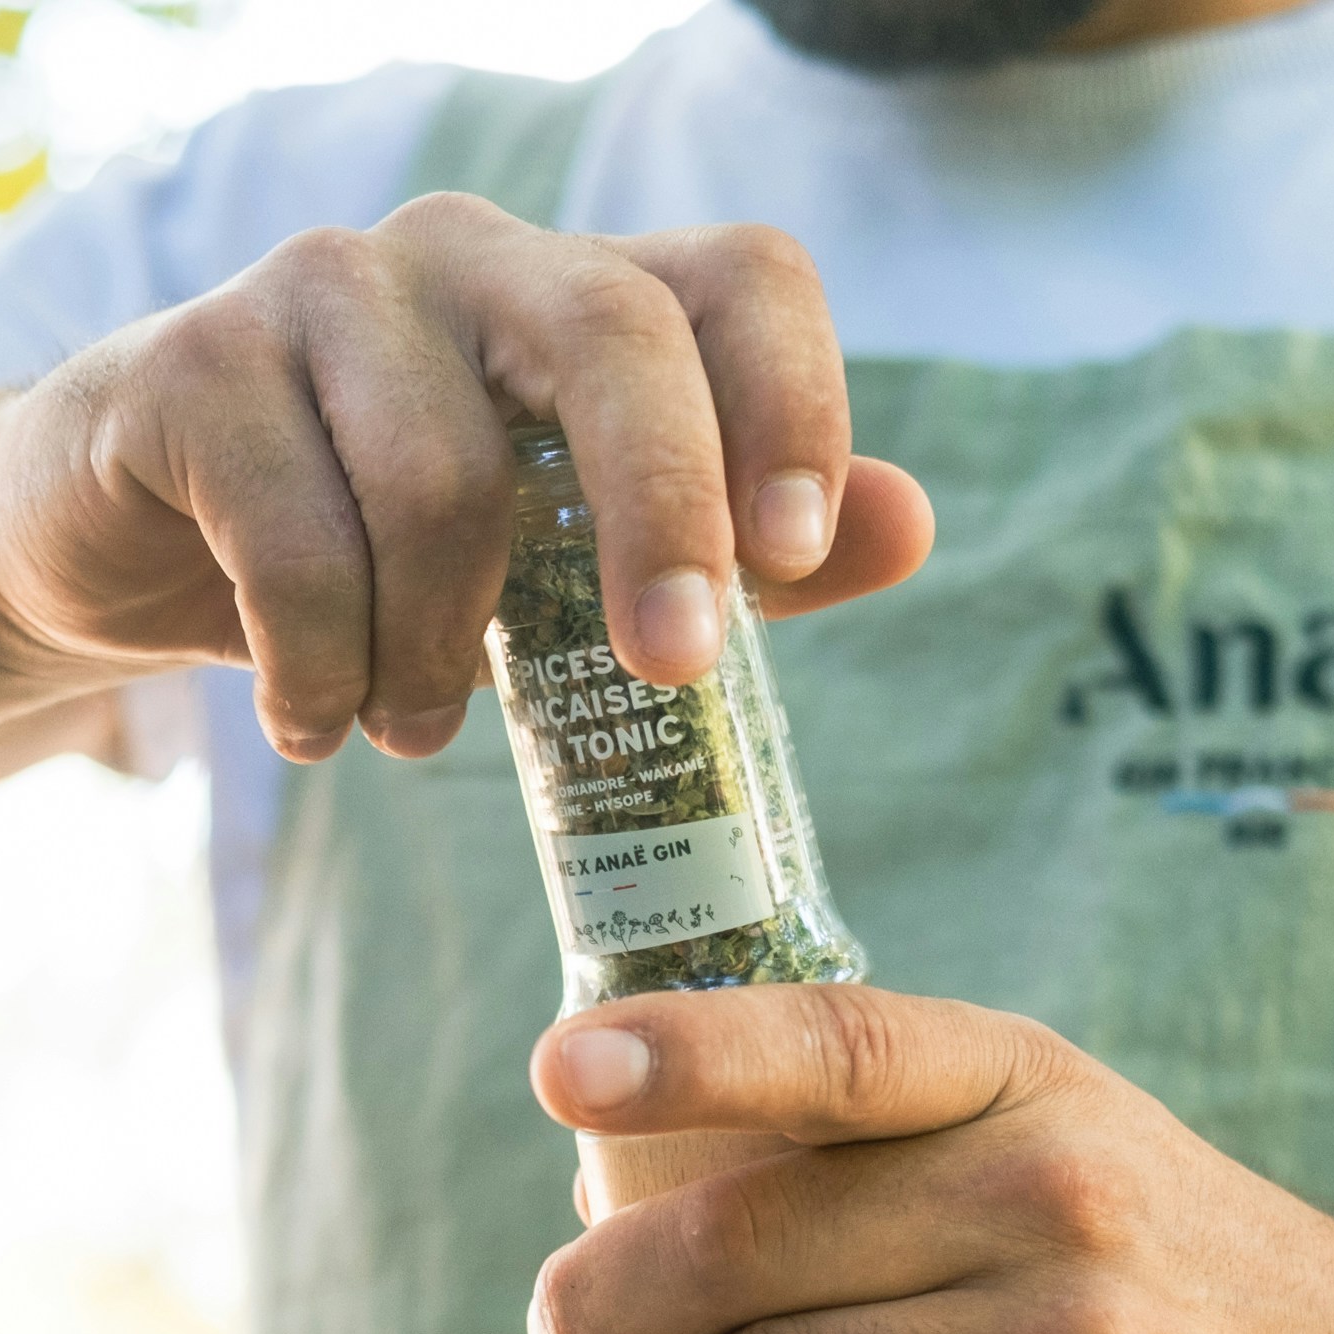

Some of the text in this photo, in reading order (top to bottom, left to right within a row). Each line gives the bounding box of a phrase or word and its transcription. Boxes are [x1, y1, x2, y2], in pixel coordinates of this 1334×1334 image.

[509, 645, 617, 689] PICES
[527, 679, 678, 731] NÇAISES
[566, 713, 684, 765] TONIC
[556, 803, 585, 818] EINE
[594, 790, 654, 813] HYSOPE
[577, 858, 591, 876] X
[594, 844, 648, 874] ANAË
[652, 838, 692, 863] GIN
